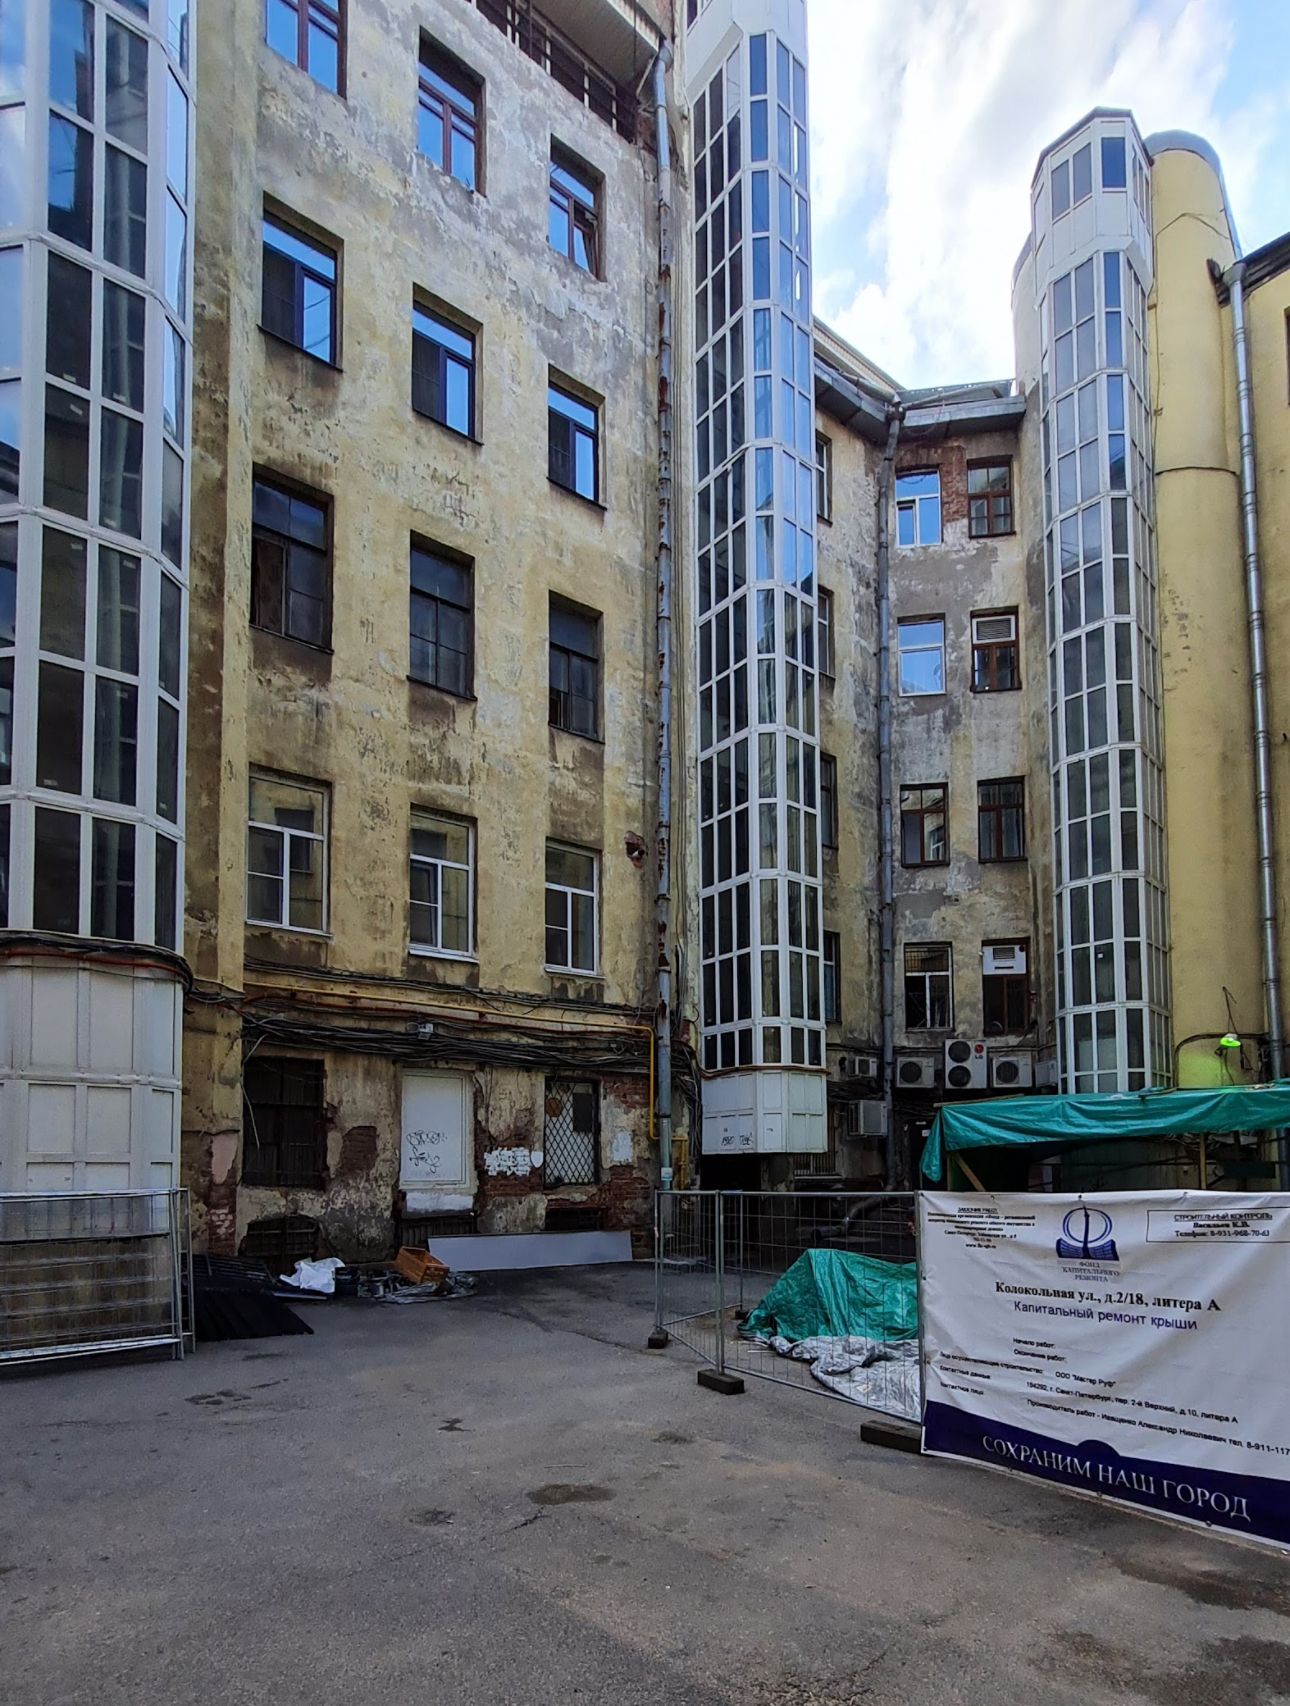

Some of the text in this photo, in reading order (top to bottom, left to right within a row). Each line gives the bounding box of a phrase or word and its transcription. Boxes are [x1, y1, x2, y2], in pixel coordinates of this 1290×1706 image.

[995, 1281, 1075, 1300] Колокольная
[1078, 1290, 1102, 1304] ул.,
[1104, 1291, 1149, 1307] д.2/18,
[1152, 1296, 1202, 1312] литера
[1014, 1301, 1198, 1330] Капитальный ремонт крыши
[1055, 1371, 1071, 1379] ООО
[982, 1435, 1252, 1523] СОХРАНИМ НАШ ГОРОД
